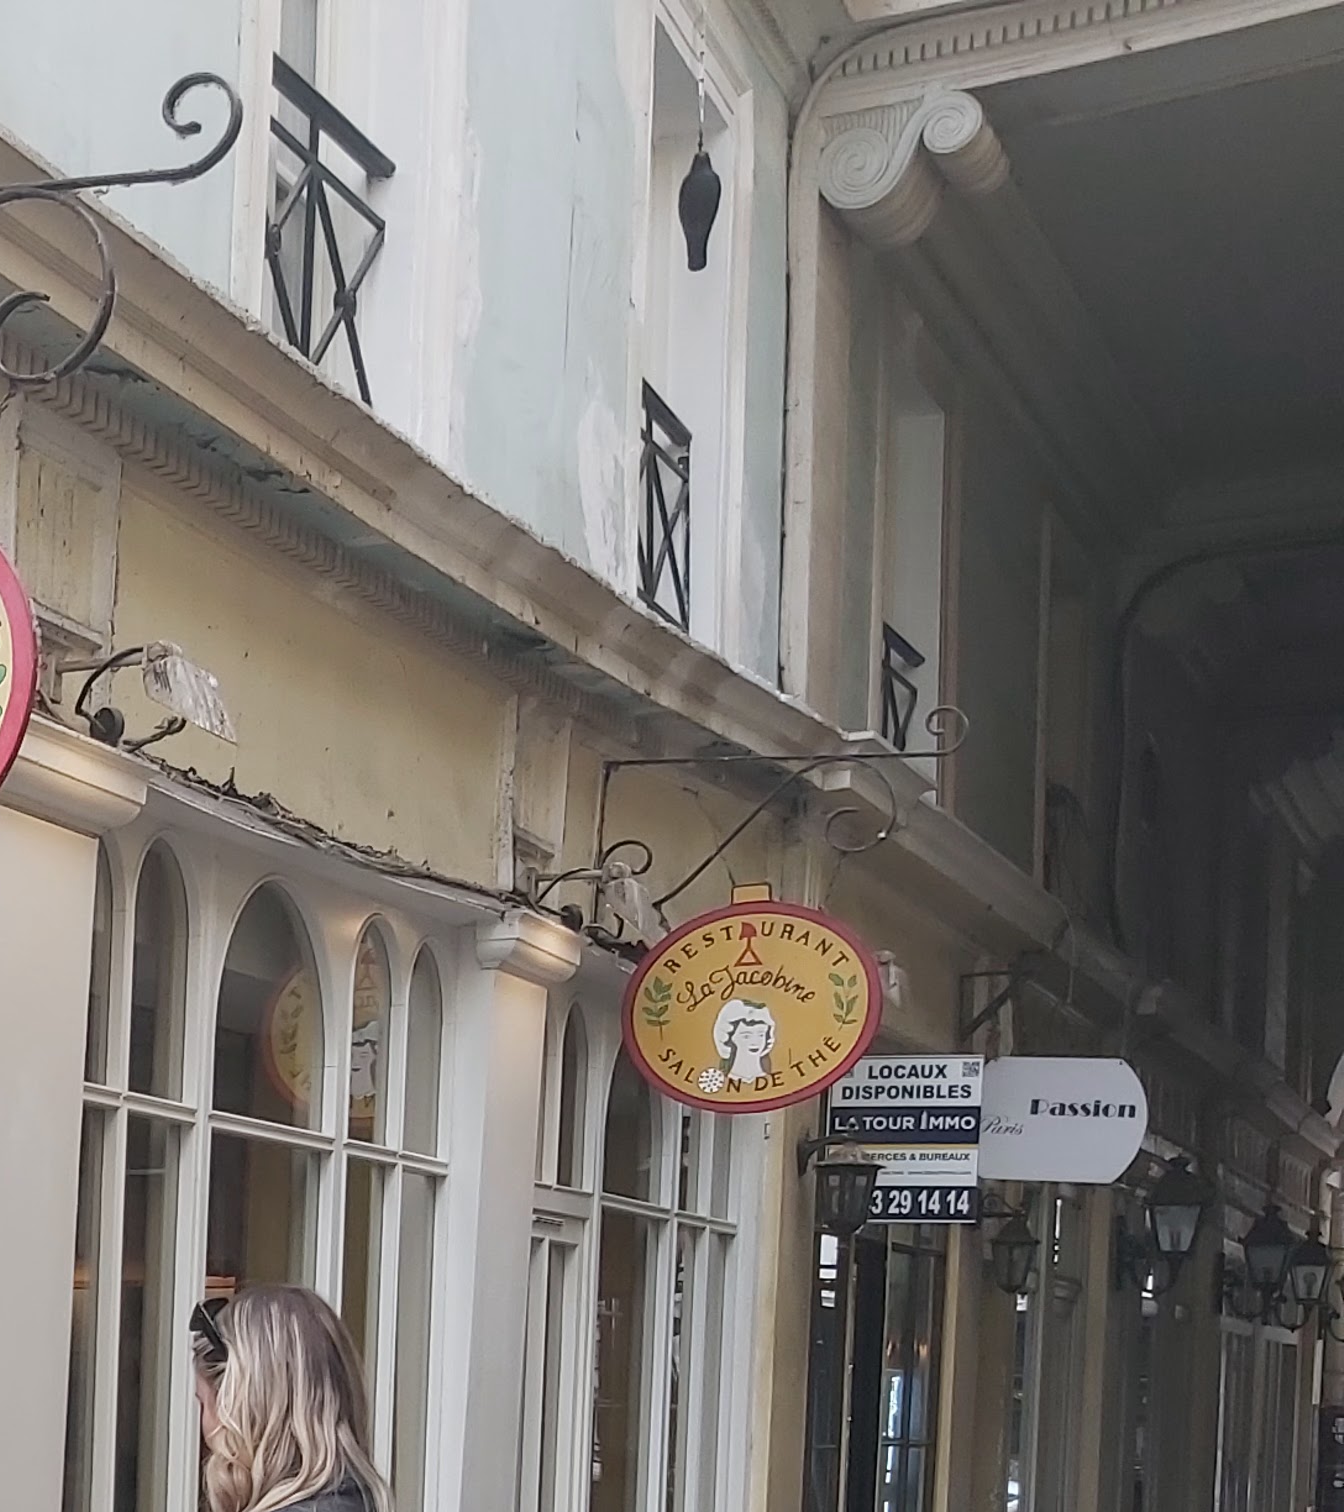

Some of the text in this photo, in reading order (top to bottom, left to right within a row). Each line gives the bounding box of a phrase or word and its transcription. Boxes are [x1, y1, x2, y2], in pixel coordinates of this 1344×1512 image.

[676, 964, 816, 1012] La Jacobine
[755, 1071, 785, 1092] DE
[868, 1064, 948, 1080] LOCAUX
[841, 1084, 972, 1100] DISPONIBLES
[1030, 1099, 1136, 1118] Passion
[834, 1110, 976, 1131] LA TOUR IMMO
[981, 1115, 1024, 1136] Paris
[867, 1153, 907, 1161] ERCES
[919, 1153, 970, 1161] BUREAUX
[869, 1189, 969, 1215] 3 29 14 14
